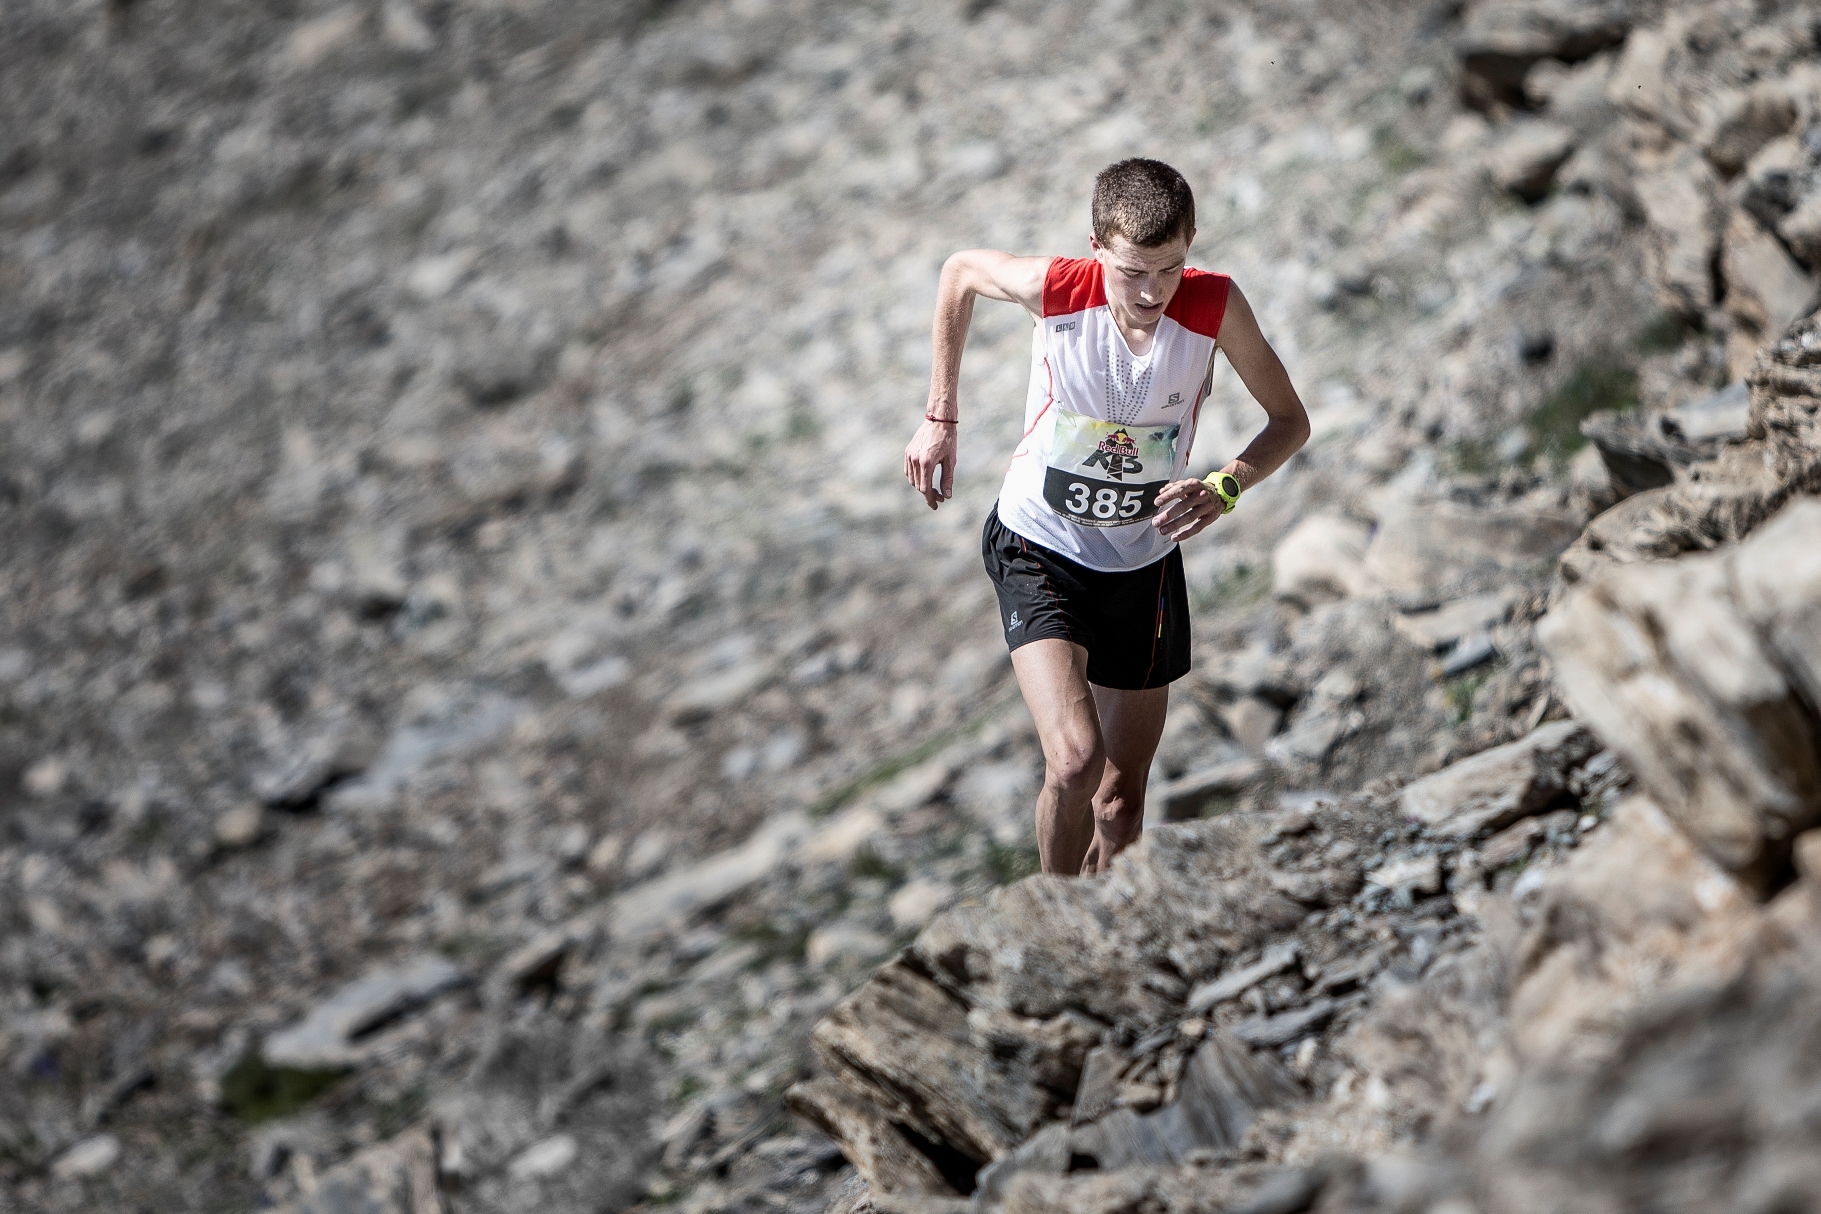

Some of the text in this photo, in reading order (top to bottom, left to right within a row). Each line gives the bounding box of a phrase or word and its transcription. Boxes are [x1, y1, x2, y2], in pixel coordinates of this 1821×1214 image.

[1098, 440, 1139, 456] Red Bull
[1065, 482, 1144, 519] 385
